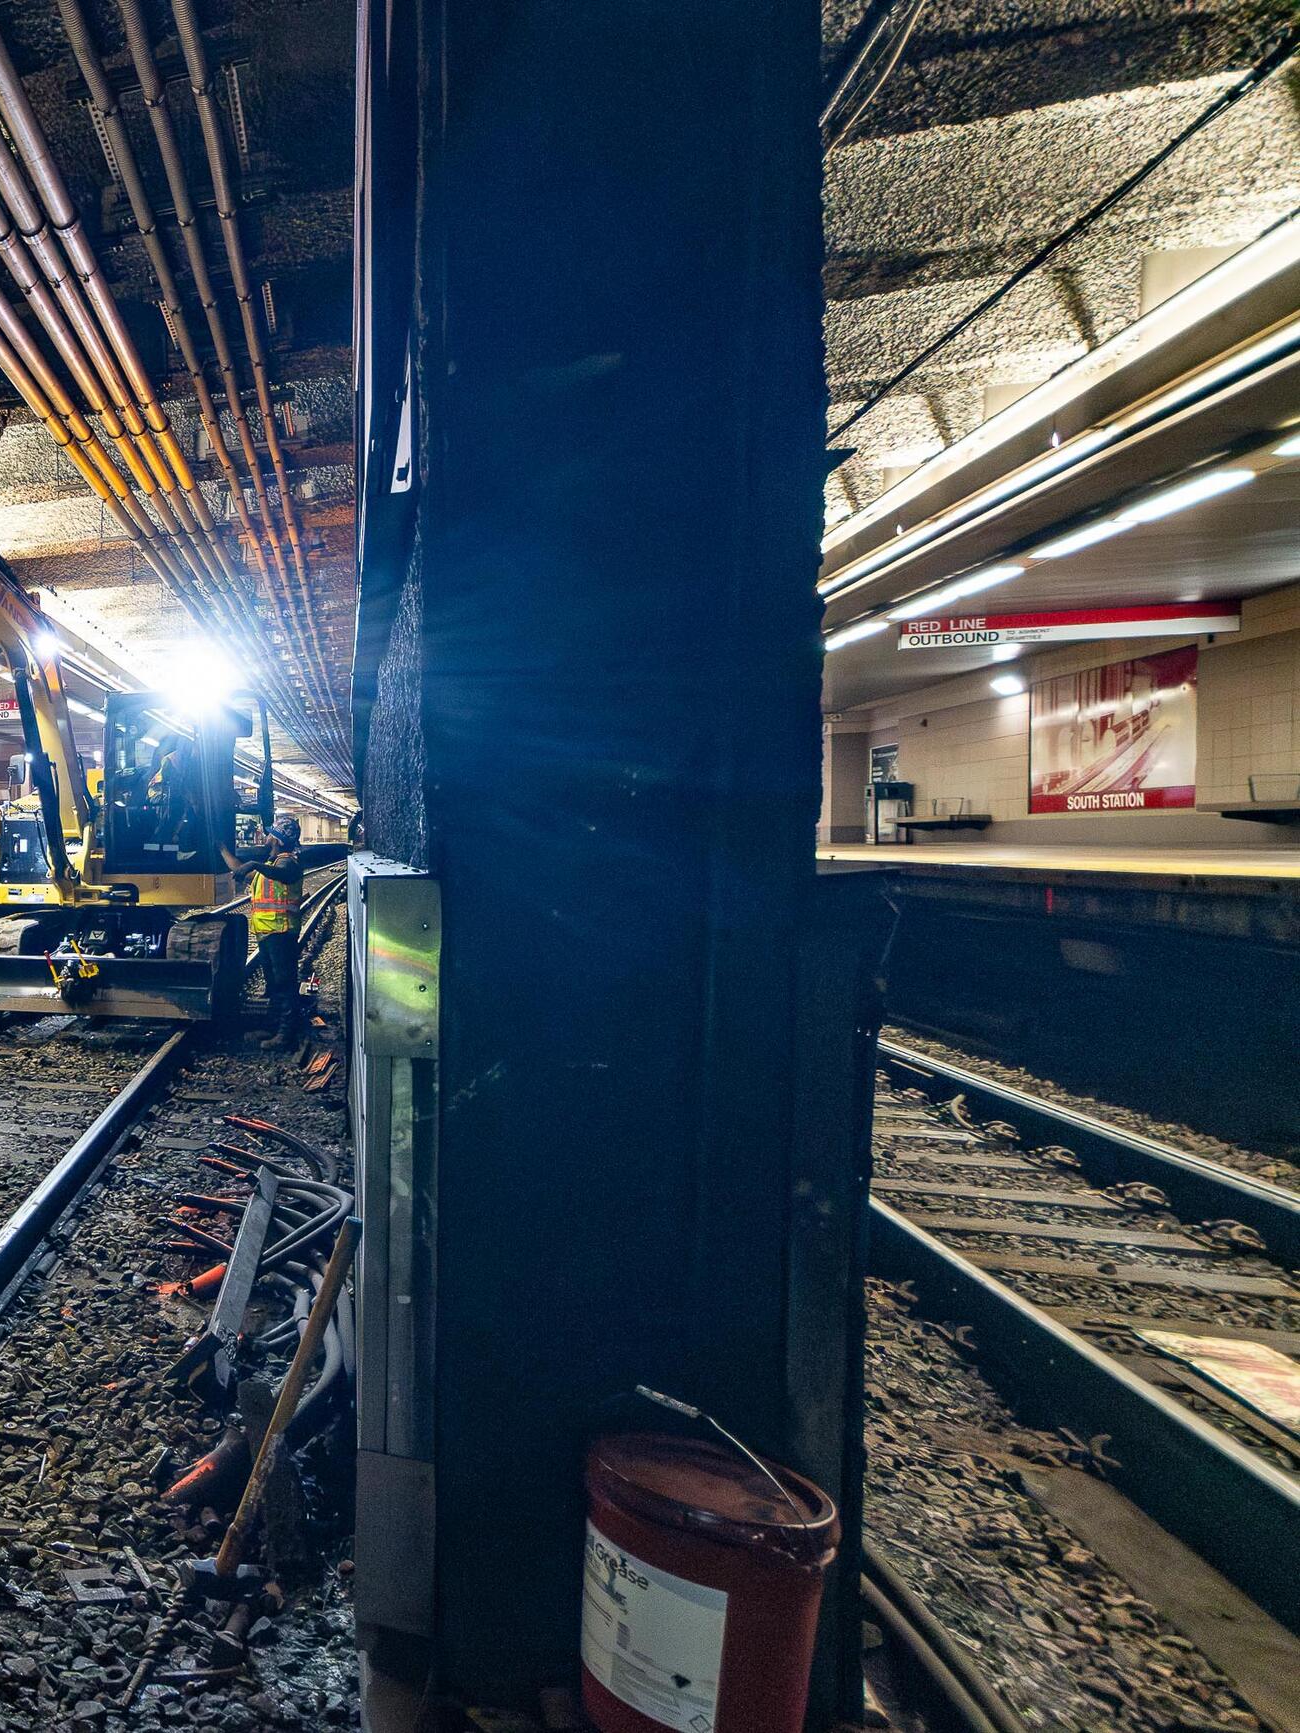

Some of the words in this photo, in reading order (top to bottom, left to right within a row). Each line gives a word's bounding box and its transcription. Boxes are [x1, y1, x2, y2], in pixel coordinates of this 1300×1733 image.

[908, 621, 941, 633] RED
[950, 618, 986, 631] LINE
[909, 631, 999, 646] OUTBOUND
[1067, 794, 1100, 810] SOUTH
[1102, 792, 1144, 808] STATION
